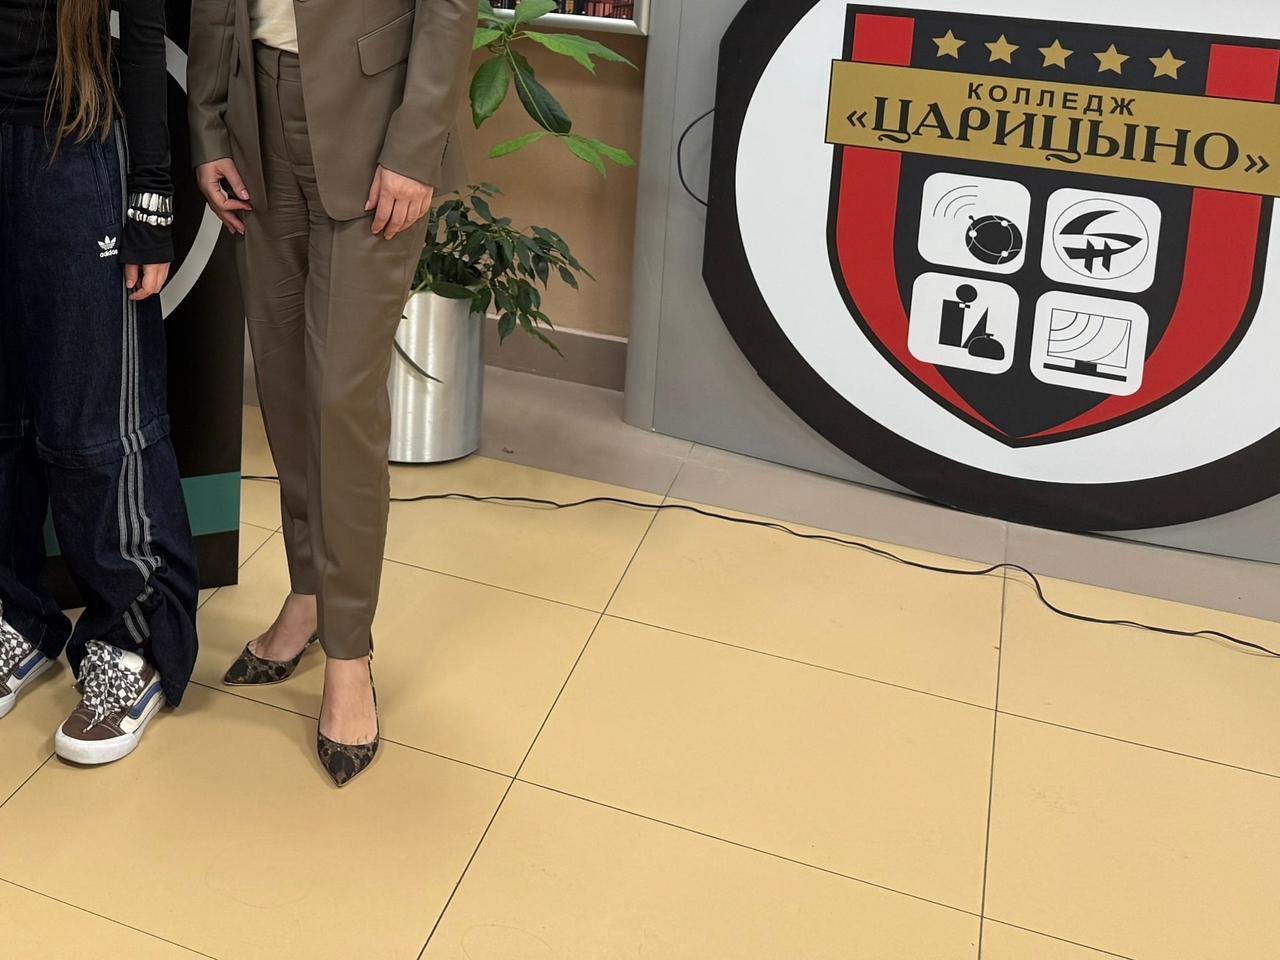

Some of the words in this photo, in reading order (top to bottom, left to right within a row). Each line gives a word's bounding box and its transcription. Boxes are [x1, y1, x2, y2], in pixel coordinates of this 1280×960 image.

[967, 81, 1136, 117] КОЛЛЕДЖ
[846, 95, 1271, 175] «ЦАРИЦЫНО»
[99, 249, 118, 258] adidas
